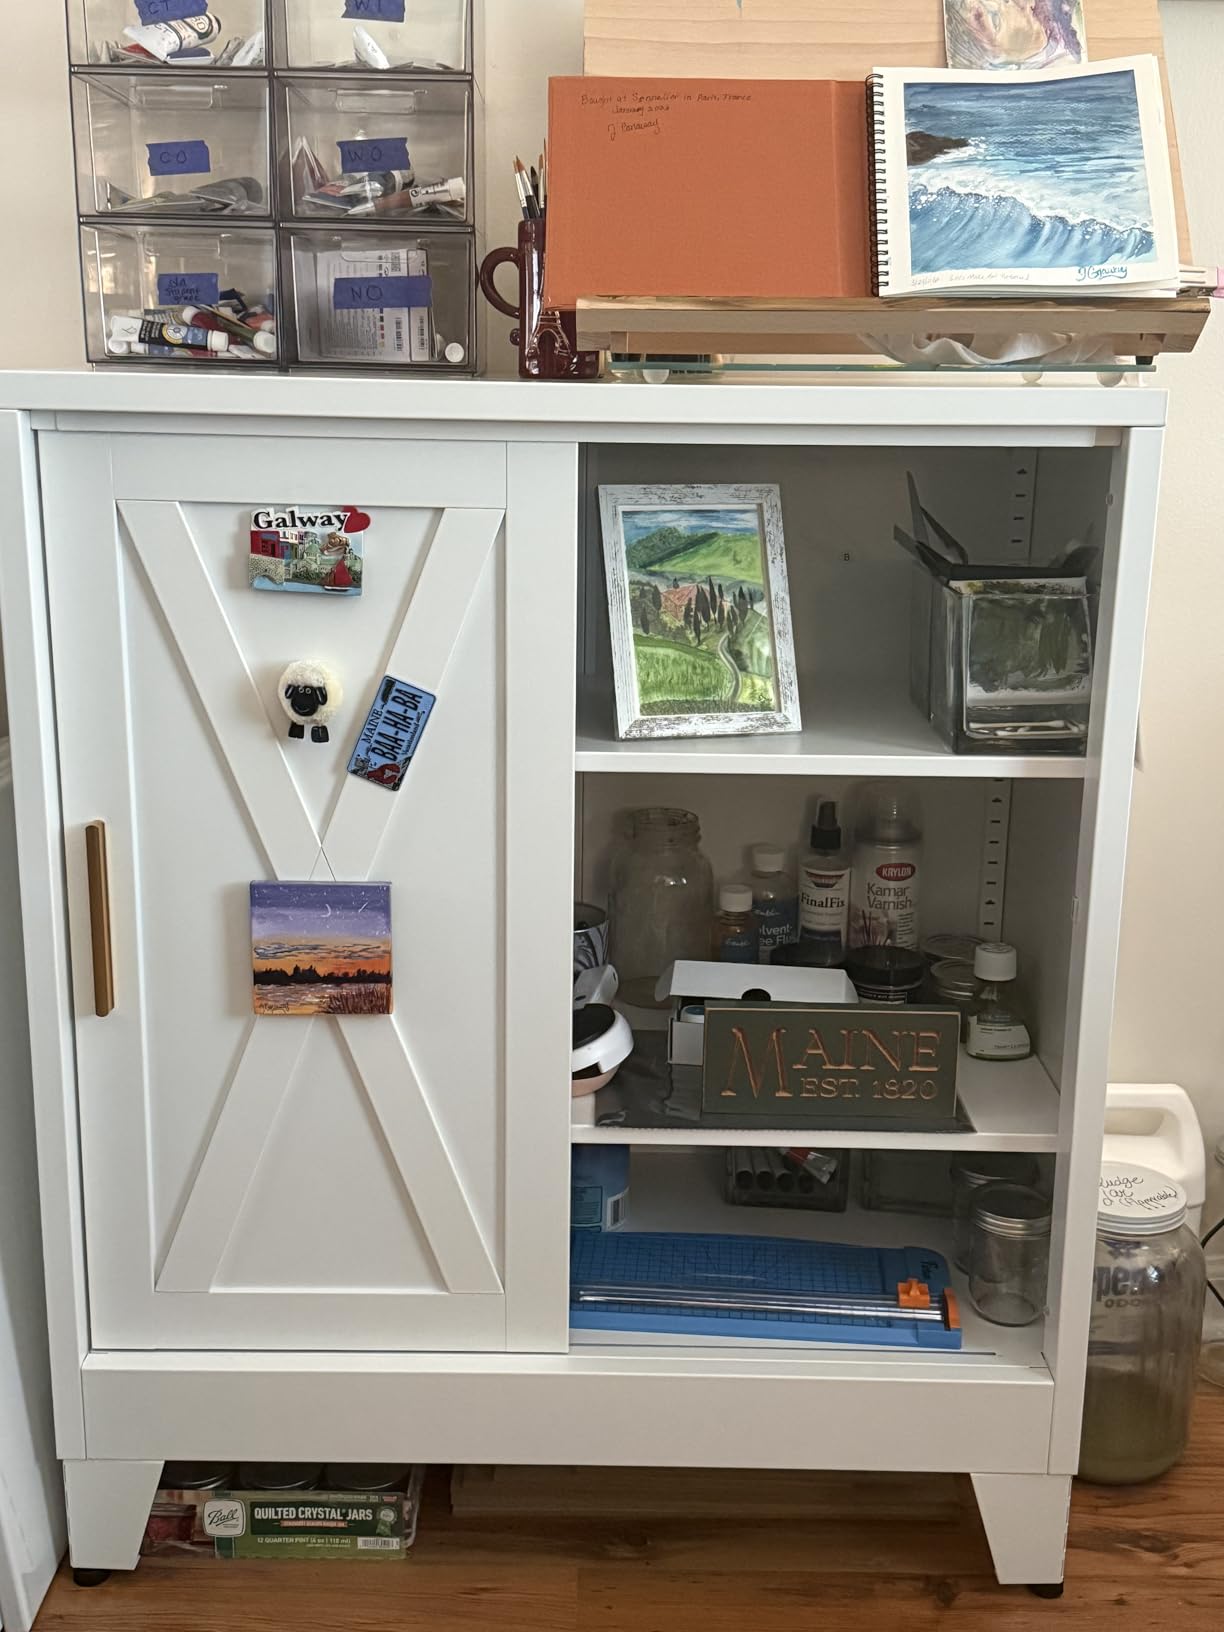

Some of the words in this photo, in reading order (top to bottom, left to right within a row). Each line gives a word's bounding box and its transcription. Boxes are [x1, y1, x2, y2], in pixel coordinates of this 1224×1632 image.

[253, 510, 348, 531] Galway
[361, 708, 383, 744] MAINE
[370, 688, 423, 762] BAA-HA-BA
[881, 866, 912, 877] KRYLON
[867, 882, 911, 897] Kamar
[867, 895, 912, 910] Varnish
[721, 1028, 942, 1098] MAINE
[800, 1078, 860, 1098] EST.
[872, 1079, 938, 1100] 1820
[1099, 1175, 1144, 1189] ludge
[207, 1508, 240, 1527] Ball
[254, 1507, 296, 1520] QUILTED
[346, 1508, 373, 1520] JARS
